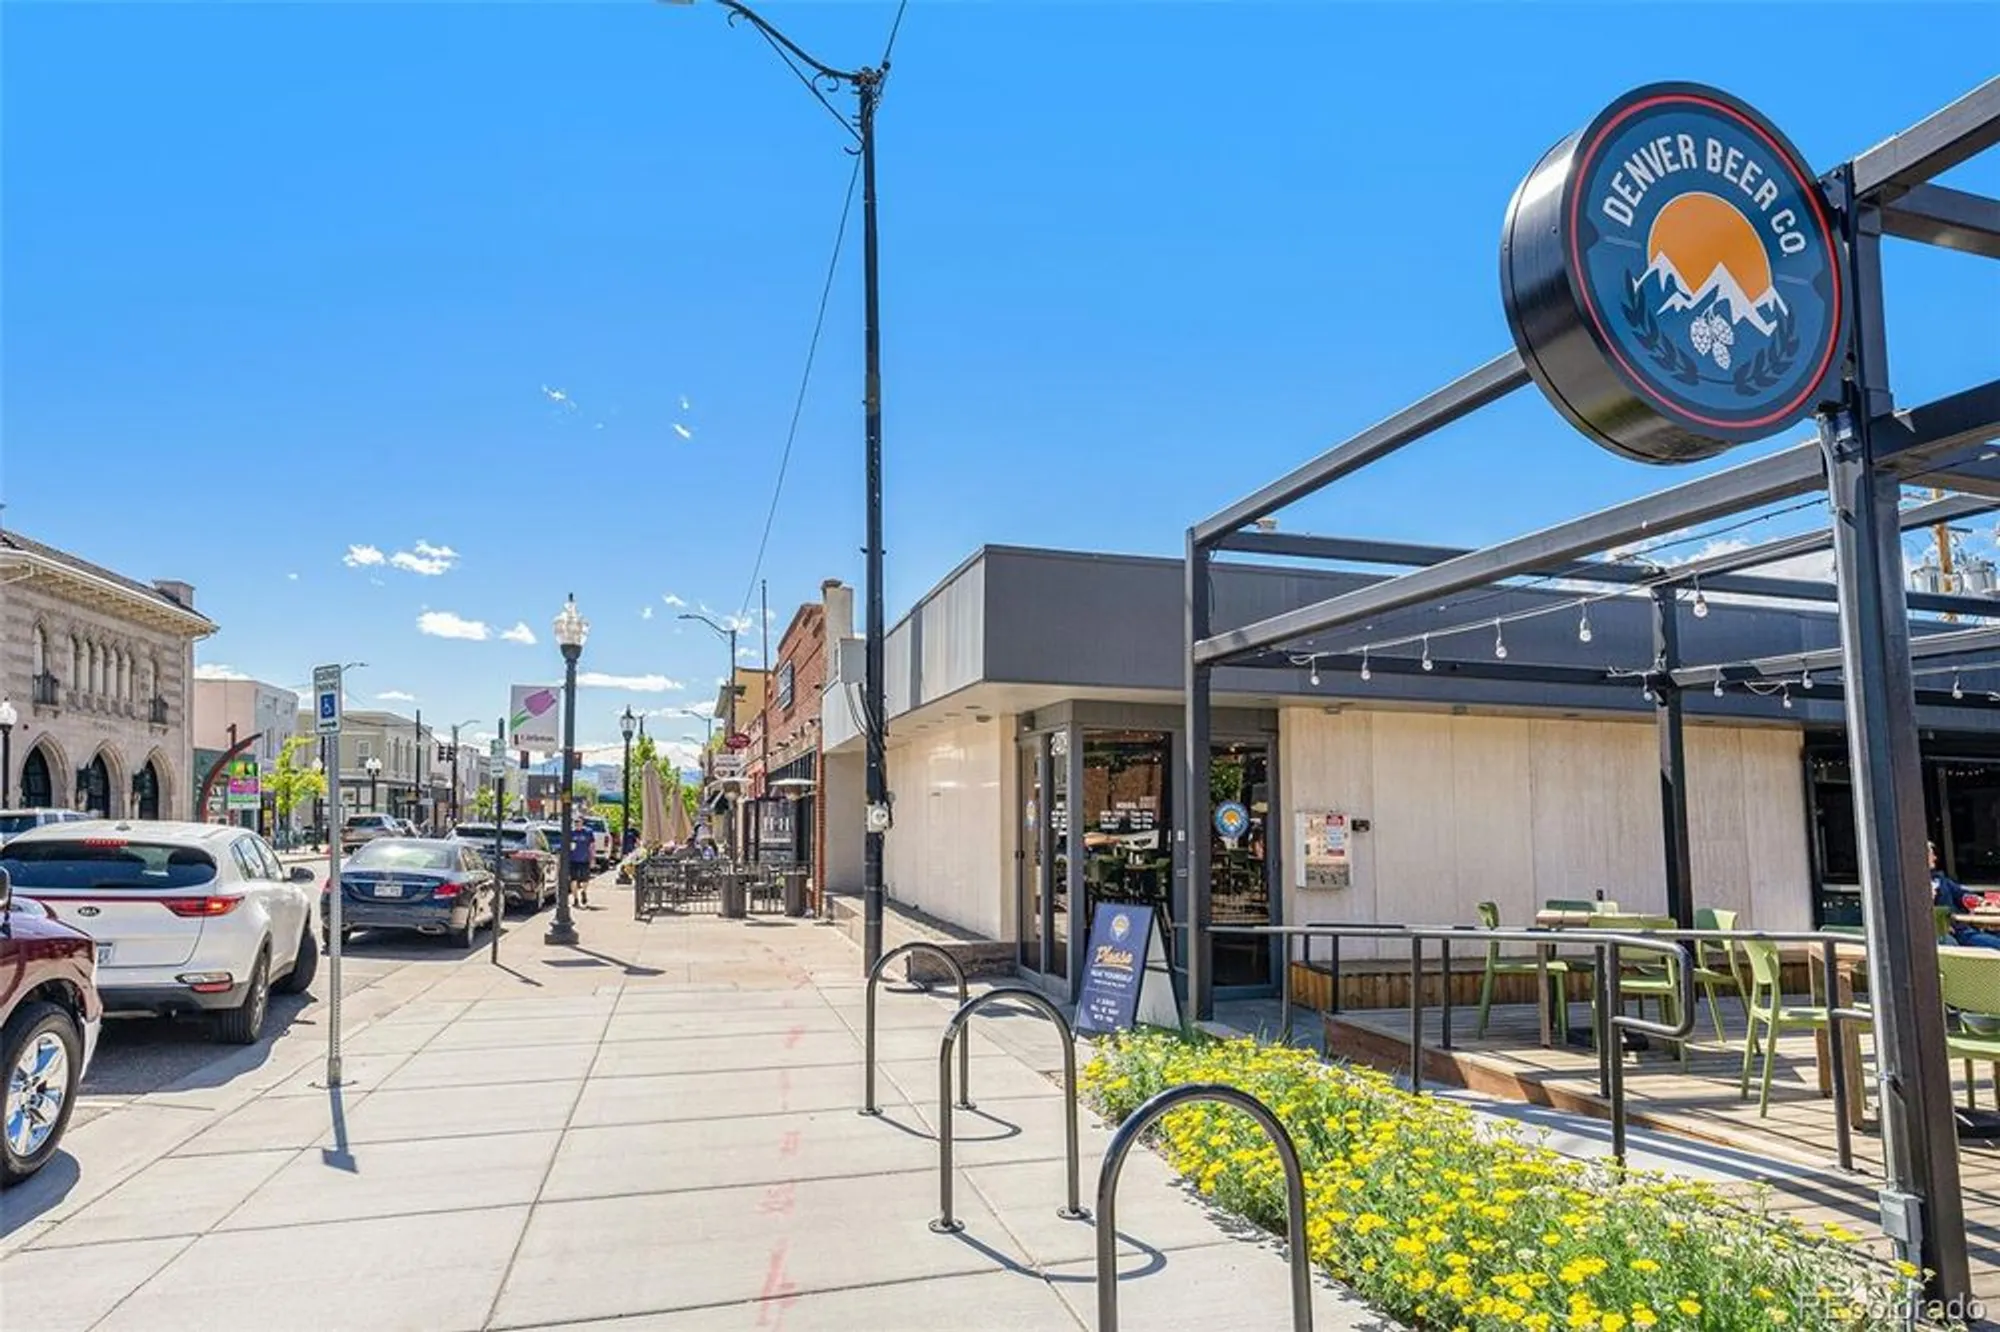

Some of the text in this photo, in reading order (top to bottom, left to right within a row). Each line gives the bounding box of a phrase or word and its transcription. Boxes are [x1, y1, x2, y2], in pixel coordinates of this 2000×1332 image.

[1602, 133, 1807, 254] DENVER BEER CO
[1094, 944, 1134, 964] Please
